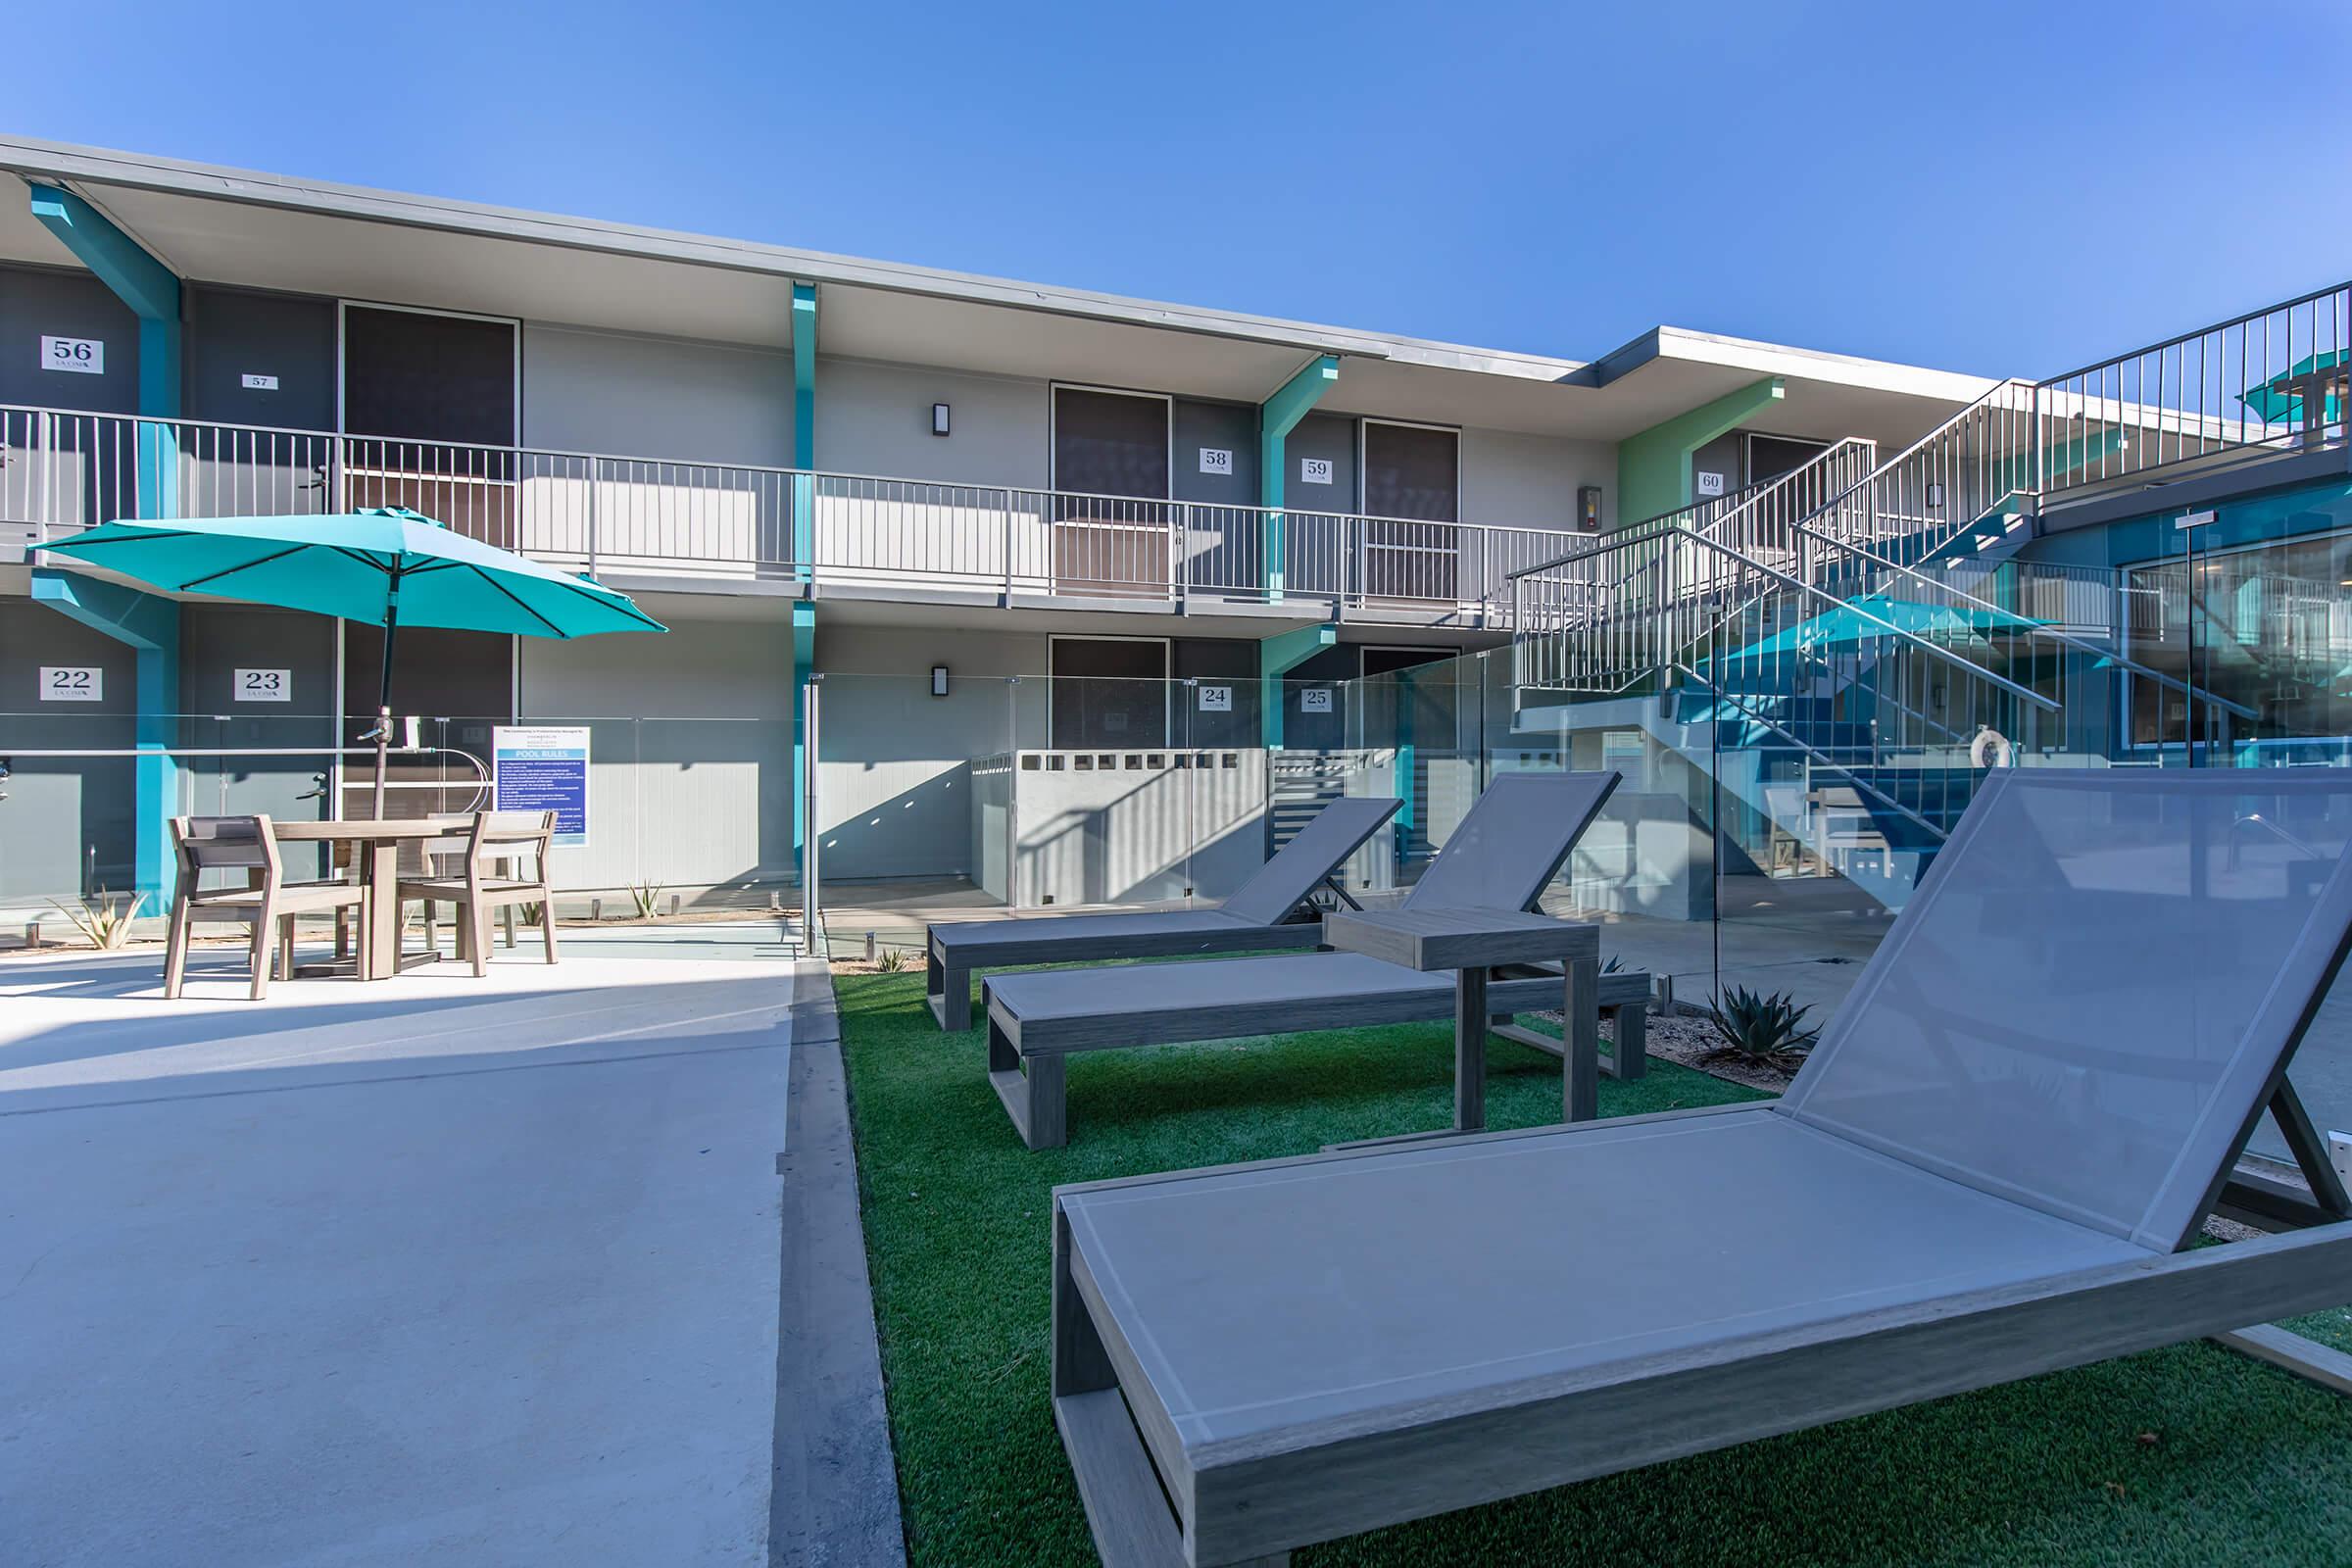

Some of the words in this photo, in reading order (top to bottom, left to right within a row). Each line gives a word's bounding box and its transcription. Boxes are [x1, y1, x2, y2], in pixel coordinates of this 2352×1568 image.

[54, 341, 91, 361] 56
[252, 377, 267, 386] 57
[1206, 452, 1226, 466] 58
[1308, 462, 1327, 475] 59
[1703, 475, 1719, 488] 60
[53, 670, 90, 688] 22
[246, 672, 280, 689] 23
[1205, 689, 1226, 703] 24
[1307, 691, 1326, 705] 25
